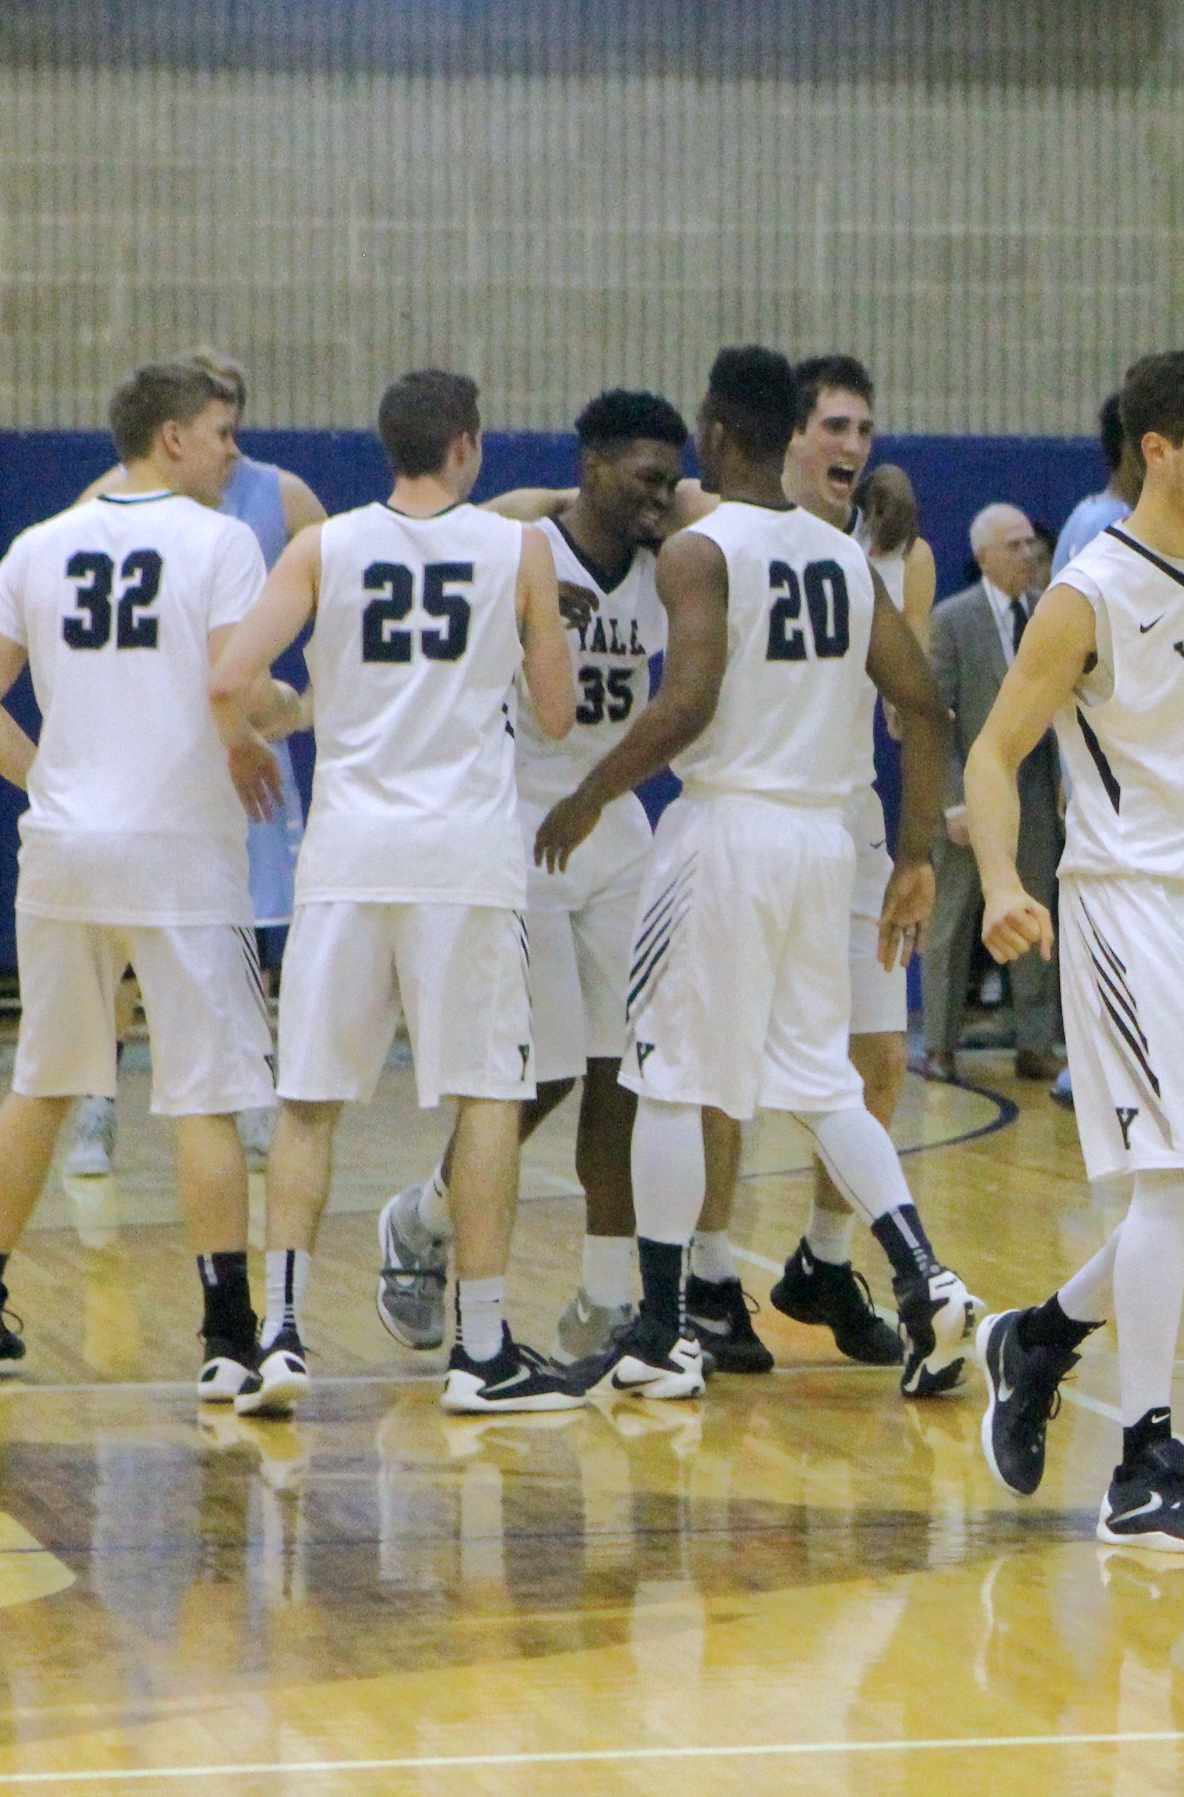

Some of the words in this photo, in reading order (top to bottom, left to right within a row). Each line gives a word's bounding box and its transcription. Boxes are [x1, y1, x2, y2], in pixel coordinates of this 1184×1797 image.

[63, 550, 162, 649] 32
[362, 562, 473, 661] 25
[766, 560, 850, 661] 20
[576, 666, 635, 725] 35
[1115, 1107, 1139, 1150] Y
